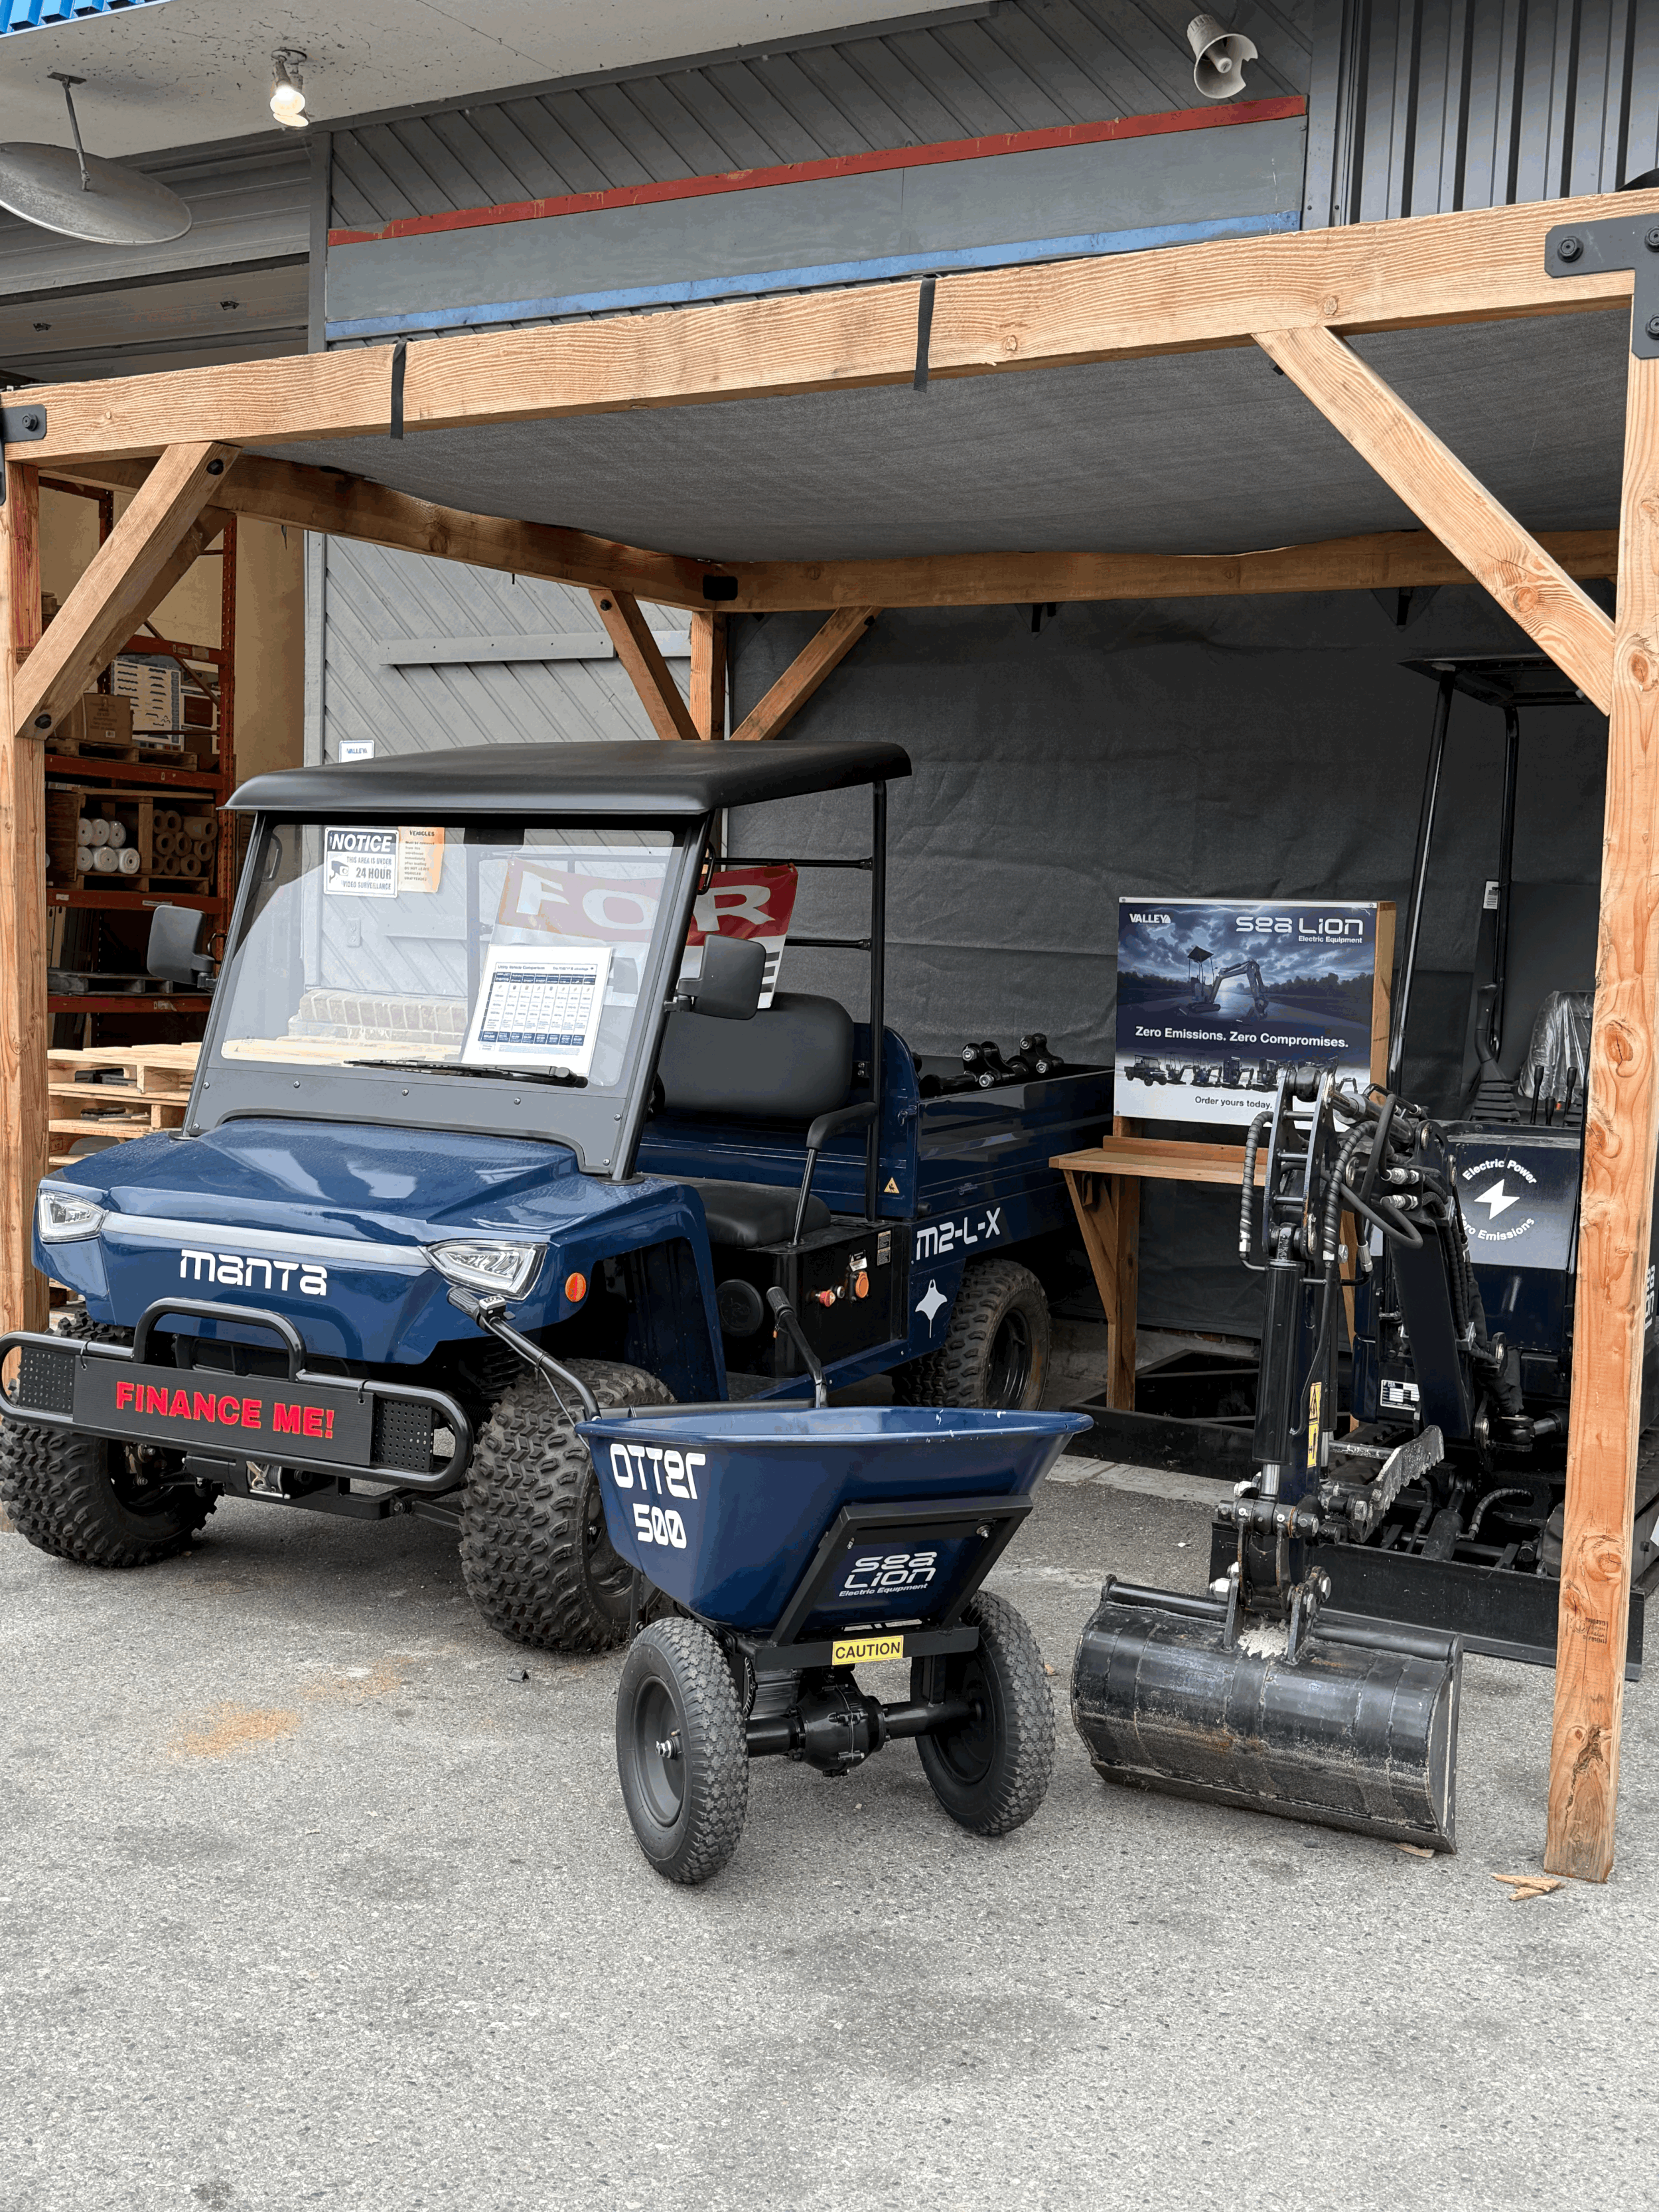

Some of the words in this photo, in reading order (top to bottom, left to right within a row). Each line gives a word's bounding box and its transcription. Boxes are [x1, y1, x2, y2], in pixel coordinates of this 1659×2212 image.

[332, 834, 392, 852] NOTICE
[356, 867, 366, 879] 24
[368, 868, 392, 880] HOUR
[358, 881, 392, 891] SURVEILLANCE
[1129, 914, 1166, 923] VALLEY
[1135, 1026, 1161, 1037] Zero
[1165, 1028, 1226, 1041] Emissions.
[1229, 1031, 1257, 1043] Zero
[1260, 1033, 1349, 1048] Compromises.
[1195, 1096, 1219, 1104] Order
[1220, 1098, 1244, 1107] yours
[1246, 1100, 1273, 1109] today.
[1462, 1158, 1505, 1181] Electric
[1507, 1159, 1537, 1184] Power
[916, 1207, 1001, 1260] M2-L-X
[1477, 1218, 1535, 1241] Emissions
[116, 1381, 262, 1429] FINANCE
[273, 1402, 335, 1439] ME!
[632, 1503, 687, 1549] 500
[877, 1583, 928, 1594] Equipment
[835, 1641, 901, 1659] CAUTION
